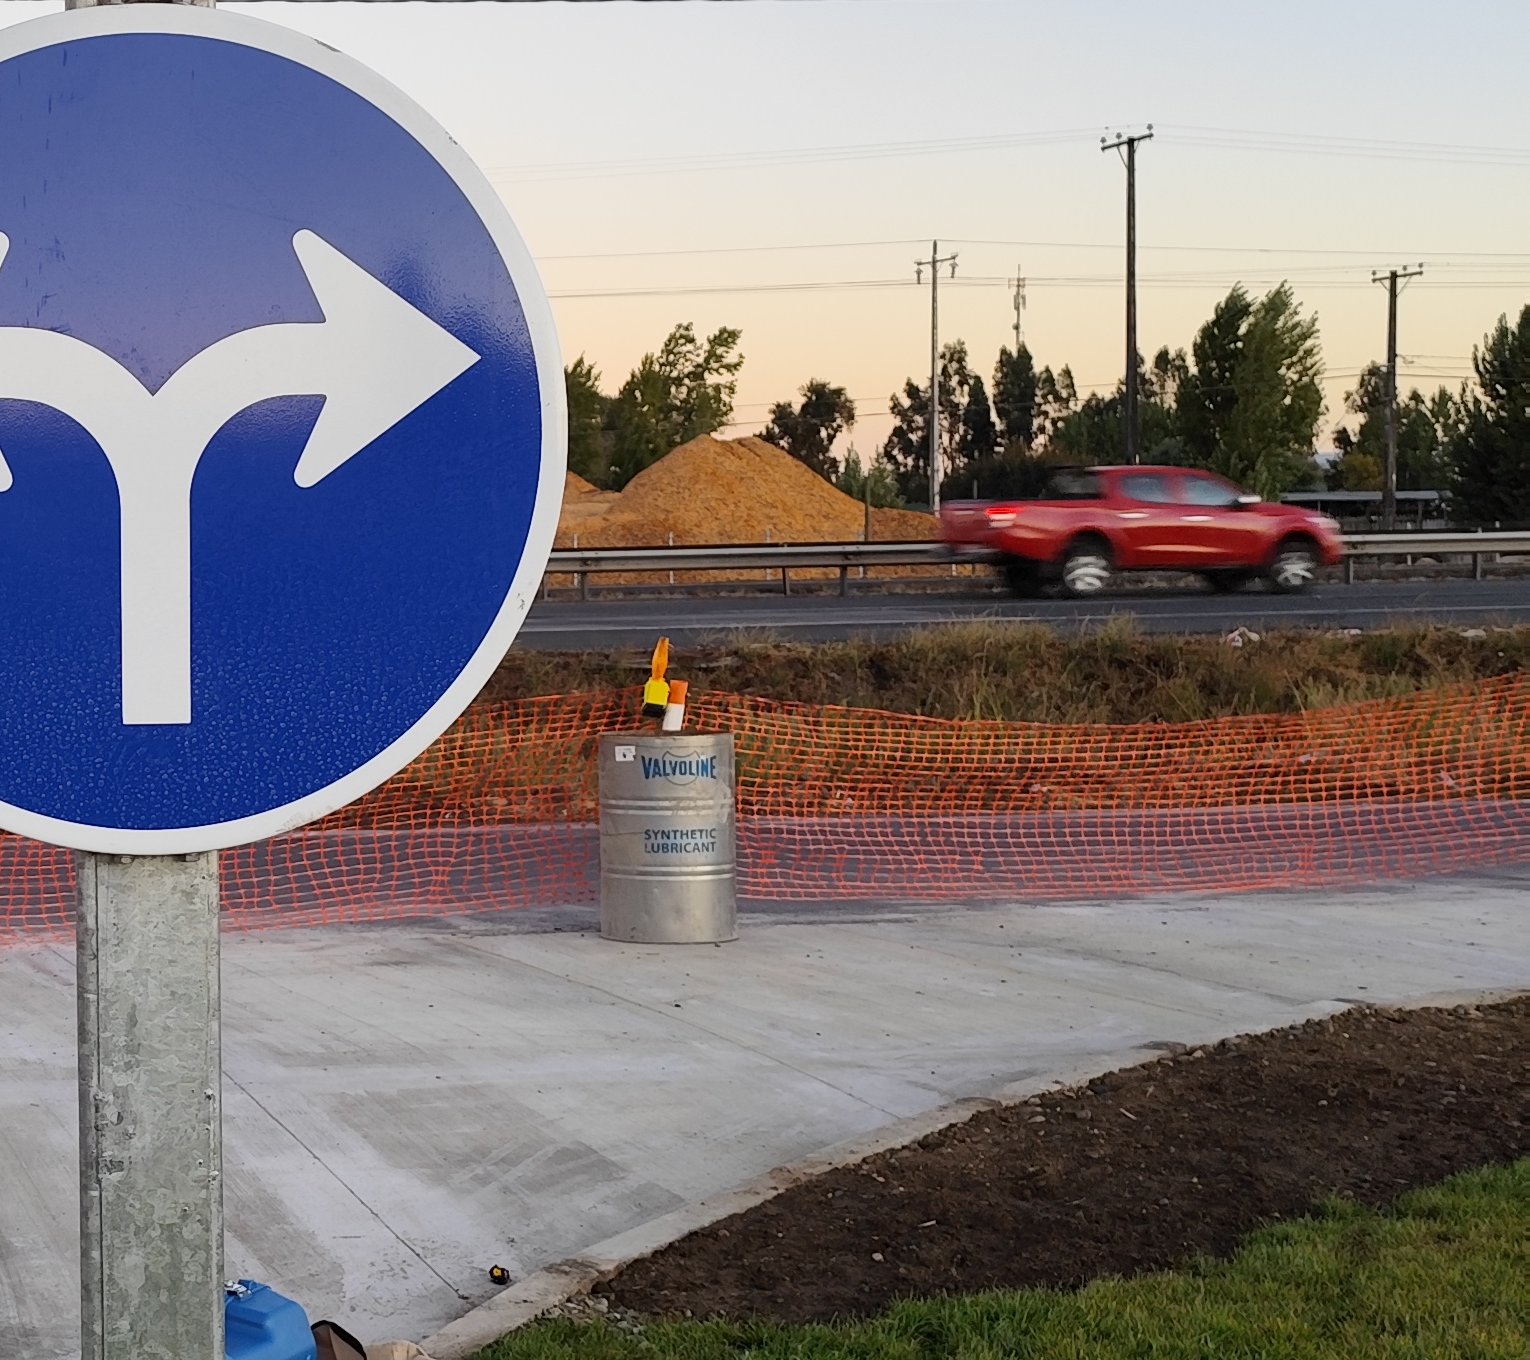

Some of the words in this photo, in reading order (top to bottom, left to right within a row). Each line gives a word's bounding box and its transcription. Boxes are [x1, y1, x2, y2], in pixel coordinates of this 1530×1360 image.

[641, 755, 717, 780] VALVOLINE
[644, 828, 717, 841] SYNTHETIC
[644, 841, 717, 854] LUBRICANT
